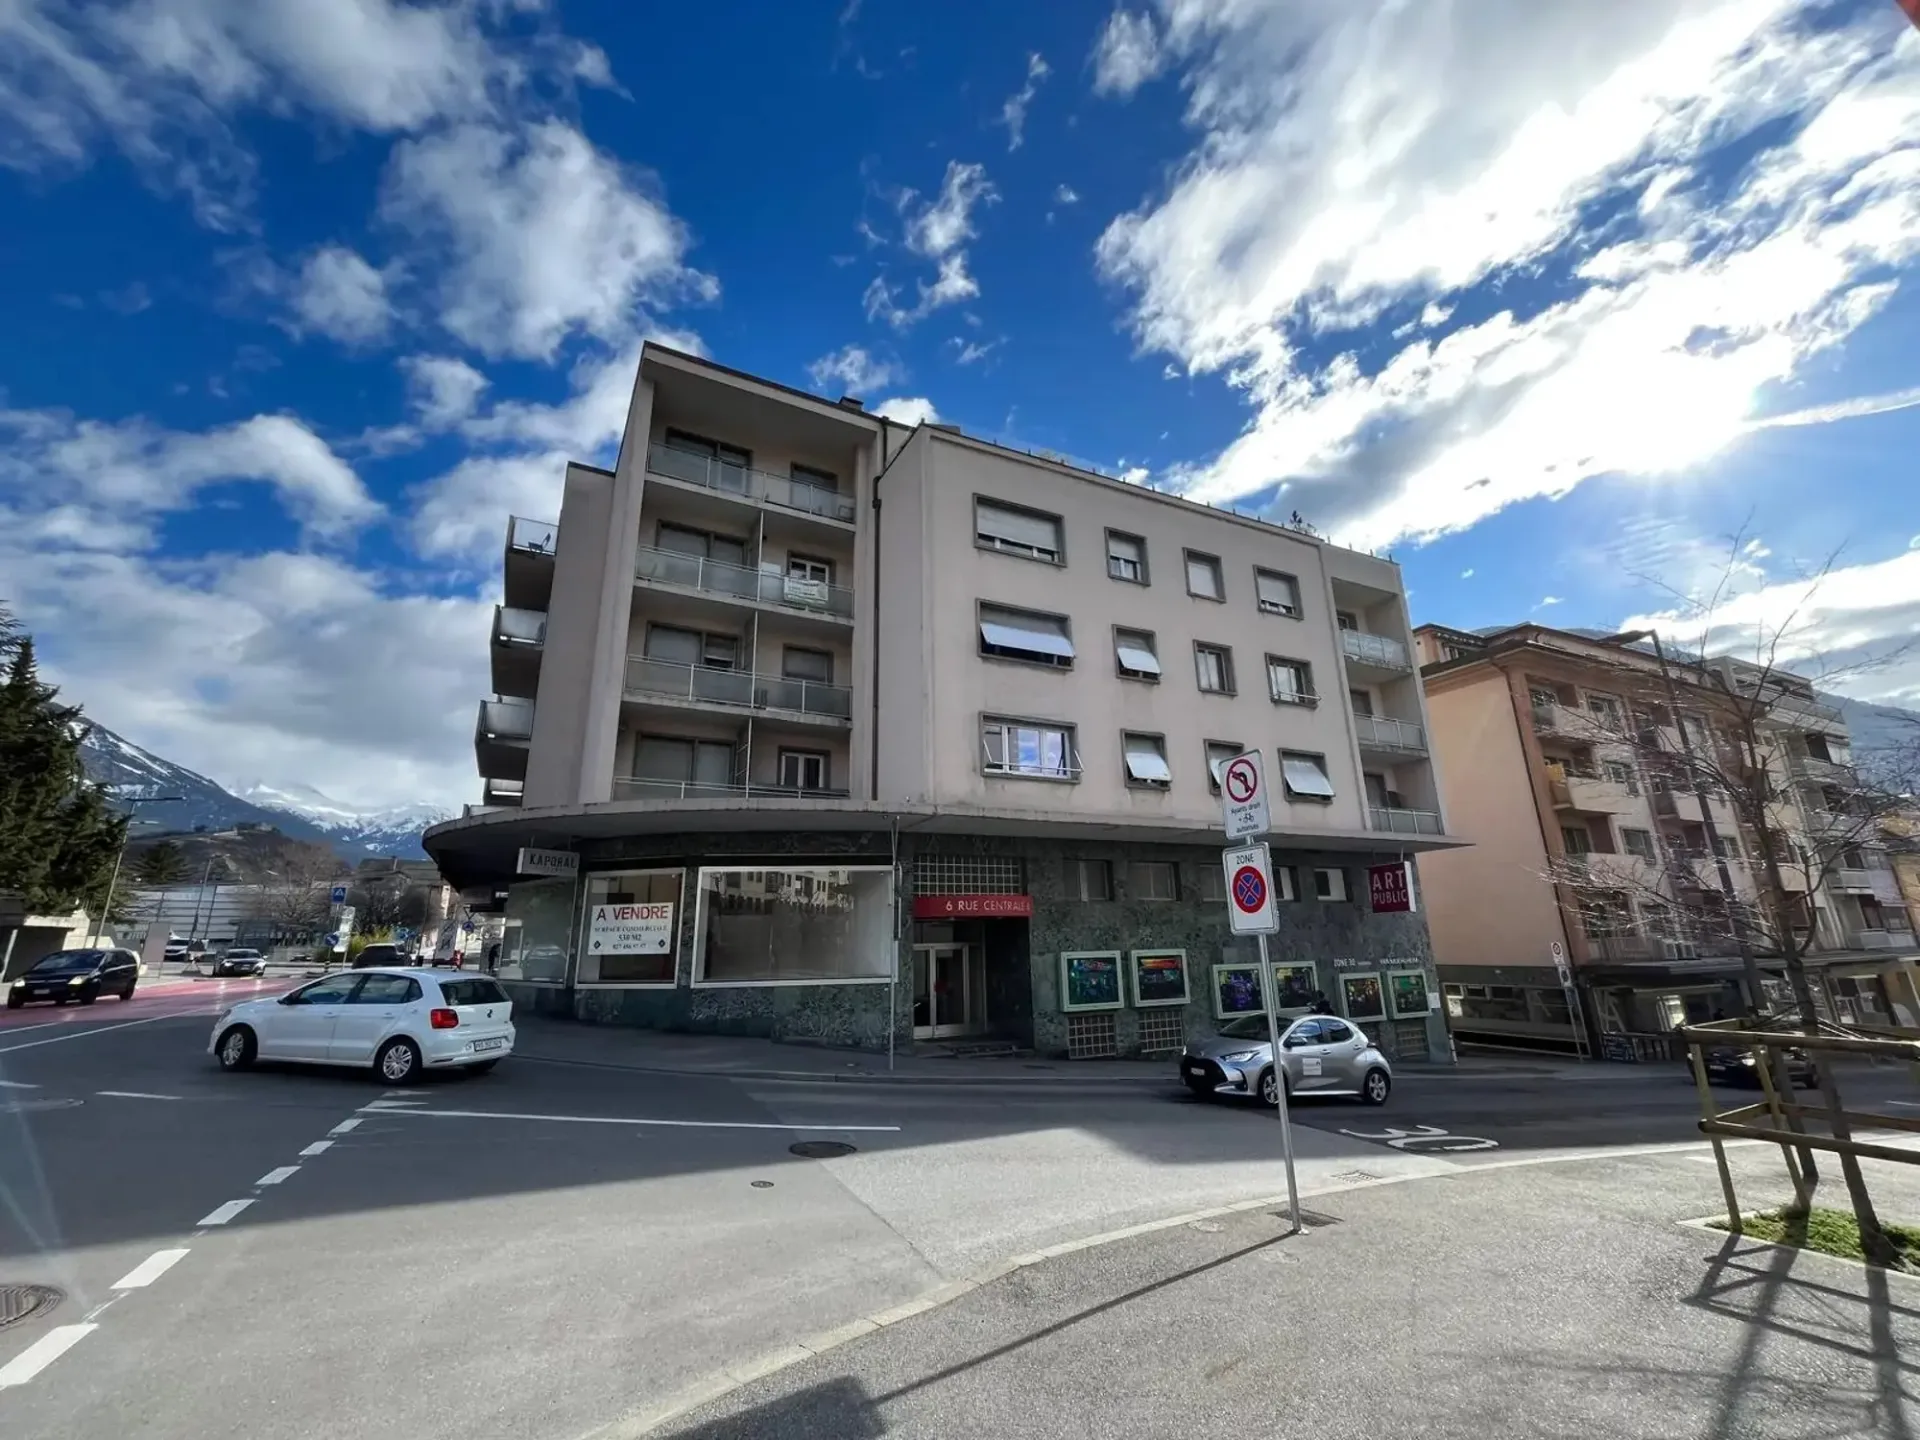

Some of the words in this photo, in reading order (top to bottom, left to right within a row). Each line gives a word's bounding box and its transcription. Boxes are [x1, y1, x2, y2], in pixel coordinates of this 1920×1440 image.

[529, 853, 577, 868] KAPORAL
[1236, 853, 1254, 865] ZONE
[1373, 870, 1404, 891] ART
[1373, 889, 1407, 905] PUBLIC
[596, 907, 606, 921] A
[612, 905, 669, 920] VENDRE
[945, 900, 953, 911] 6
[958, 900, 979, 911] RUE
